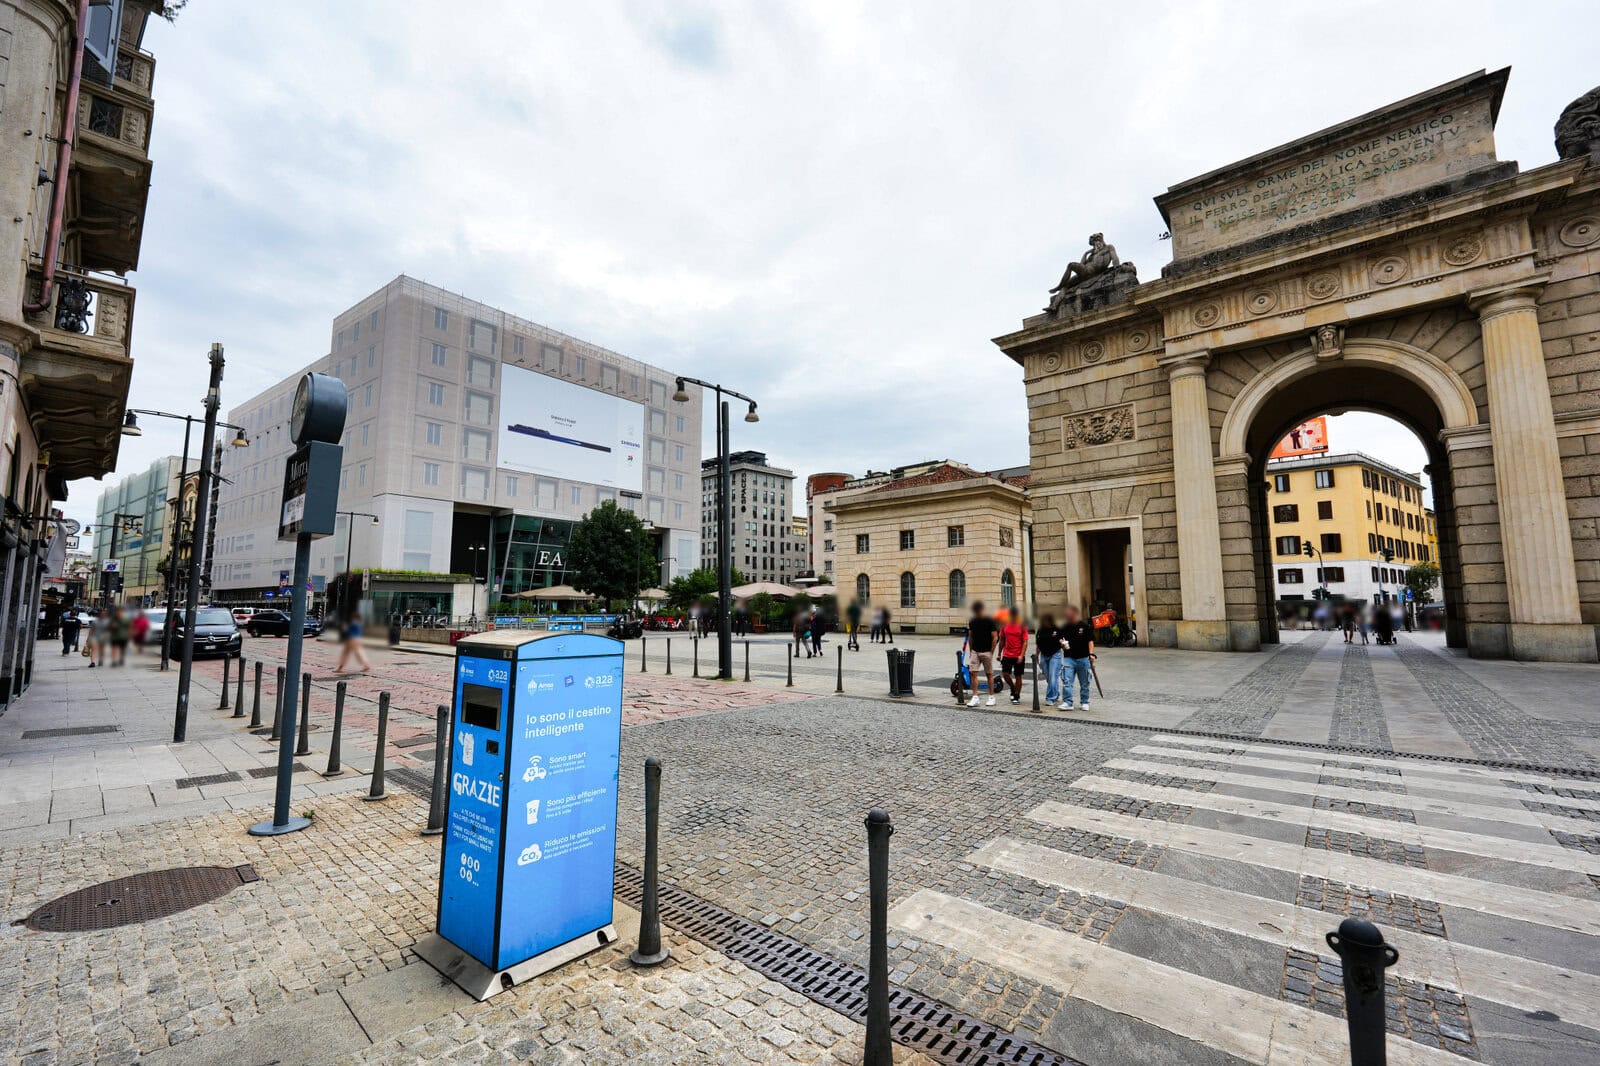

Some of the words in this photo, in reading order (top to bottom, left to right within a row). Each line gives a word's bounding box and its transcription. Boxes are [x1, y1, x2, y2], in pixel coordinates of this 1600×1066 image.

[1193, 198, 1216, 211] QVI
[1256, 168, 1297, 188] ORME
[1302, 158, 1328, 174] DEL
[1334, 139, 1380, 162] NOME
[1386, 114, 1454, 144] NEMICO
[1190, 216, 1203, 225] IL
[1205, 198, 1248, 219] FERRO
[1253, 184, 1298, 204] DELLA
[1305, 160, 1366, 186] ITALICA
[1370, 126, 1460, 163] GIOVENTV
[1214, 208, 1255, 228] INCISE
[1261, 201, 1277, 214] LE
[537, 551, 563, 566] EA
[496, 670, 508, 680] a2a
[596, 675, 613, 685] a2a
[526, 714, 537, 725] Io
[540, 712, 566, 723] sono
[568, 708, 574, 719] il
[576, 705, 612, 718] cestino
[525, 722, 584, 739] intelligente
[549, 756, 566, 764] Sono
[568, 752, 586, 761] smart
[453, 772, 500, 808] GRAZIE
[546, 799, 564, 807] Sono
[565, 795, 576, 804] più
[577, 788, 607, 799] efficiente
[577, 824, 606, 838] emissioni
